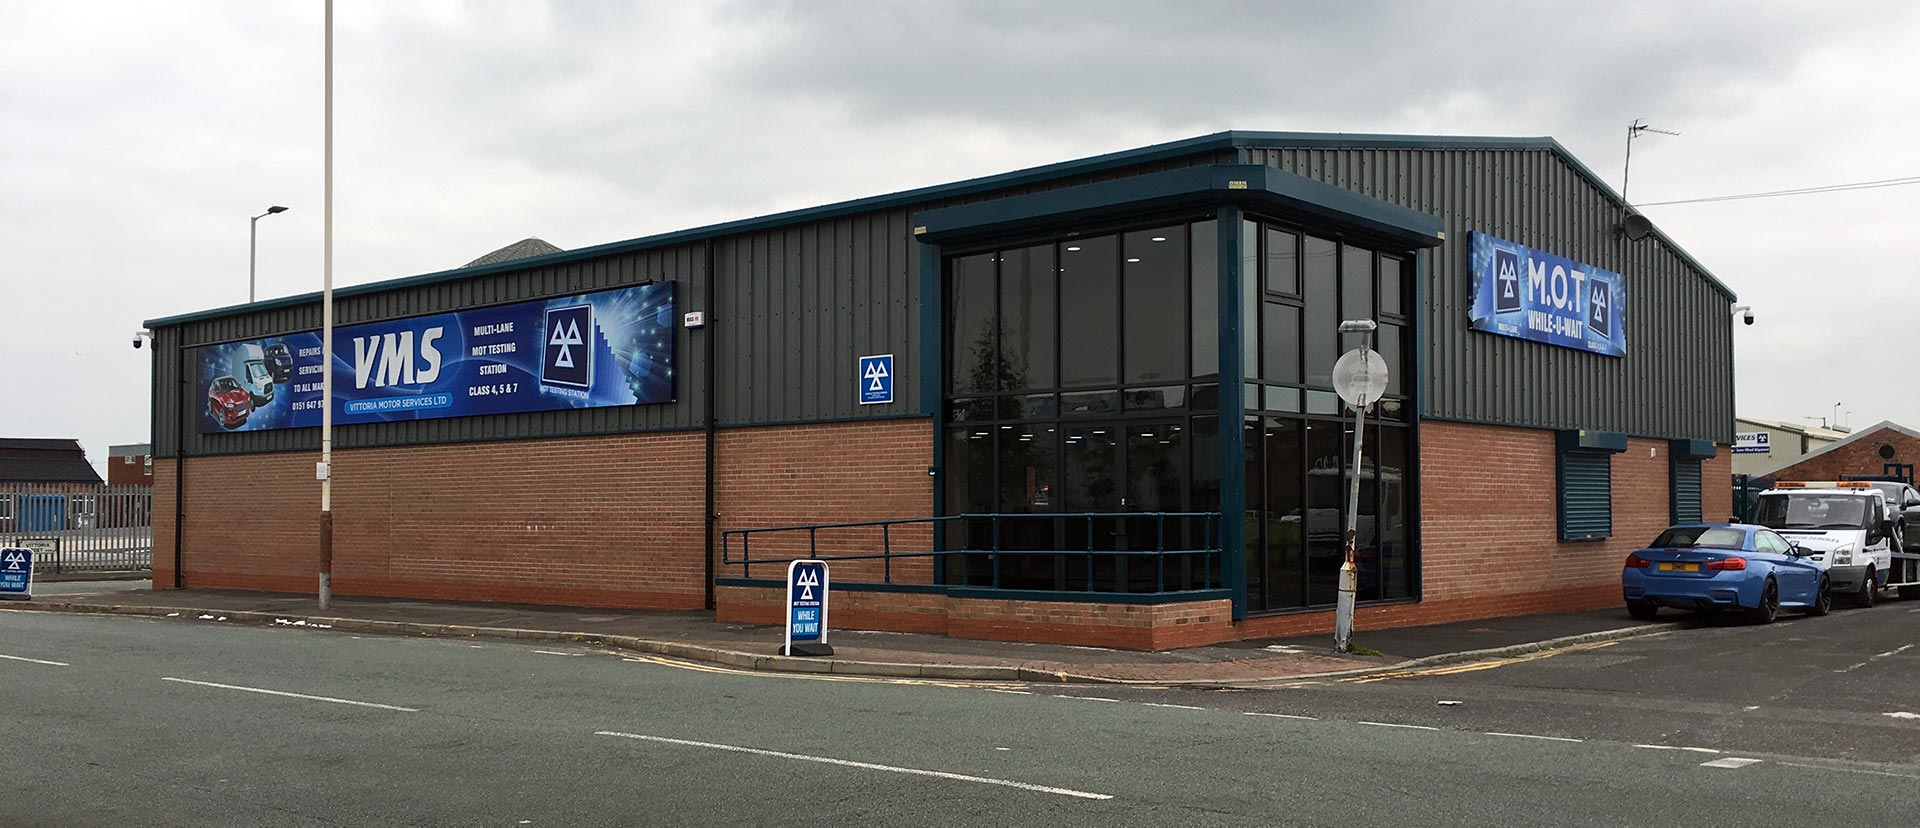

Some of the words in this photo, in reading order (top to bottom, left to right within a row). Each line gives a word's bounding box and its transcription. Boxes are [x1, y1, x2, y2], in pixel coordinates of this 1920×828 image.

[1528, 257, 1585, 313] M.O.T
[474, 322, 514, 336] MULTI-LANE
[1528, 310, 1583, 339] WHILE-U-WAIT
[299, 346, 321, 357] REPAIRS
[472, 345, 487, 356] MOT
[488, 342, 516, 354] TESTING
[353, 326, 443, 389] VMS
[480, 363, 507, 375] STATION
[294, 384, 301, 392] TO
[302, 383, 311, 392] ALL
[469, 385, 490, 396] CLASS
[491, 385, 498, 395] 4,
[500, 384, 504, 393] 5
[506, 384, 512, 393] &
[513, 383, 518, 392] 7
[549, 386, 568, 396] TESTING
[568, 389, 590, 399] STATION
[292, 402, 305, 411] 0151
[306, 400, 317, 409] 647
[349, 403, 377, 412] VITTORIA
[378, 399, 401, 409] MOTOR
[402, 397, 433, 408] SERVICES
[433, 395, 447, 405] LTD
[798, 611, 815, 620] WHILE
[793, 623, 804, 633] YOU
[805, 623, 818, 633] WAIT
